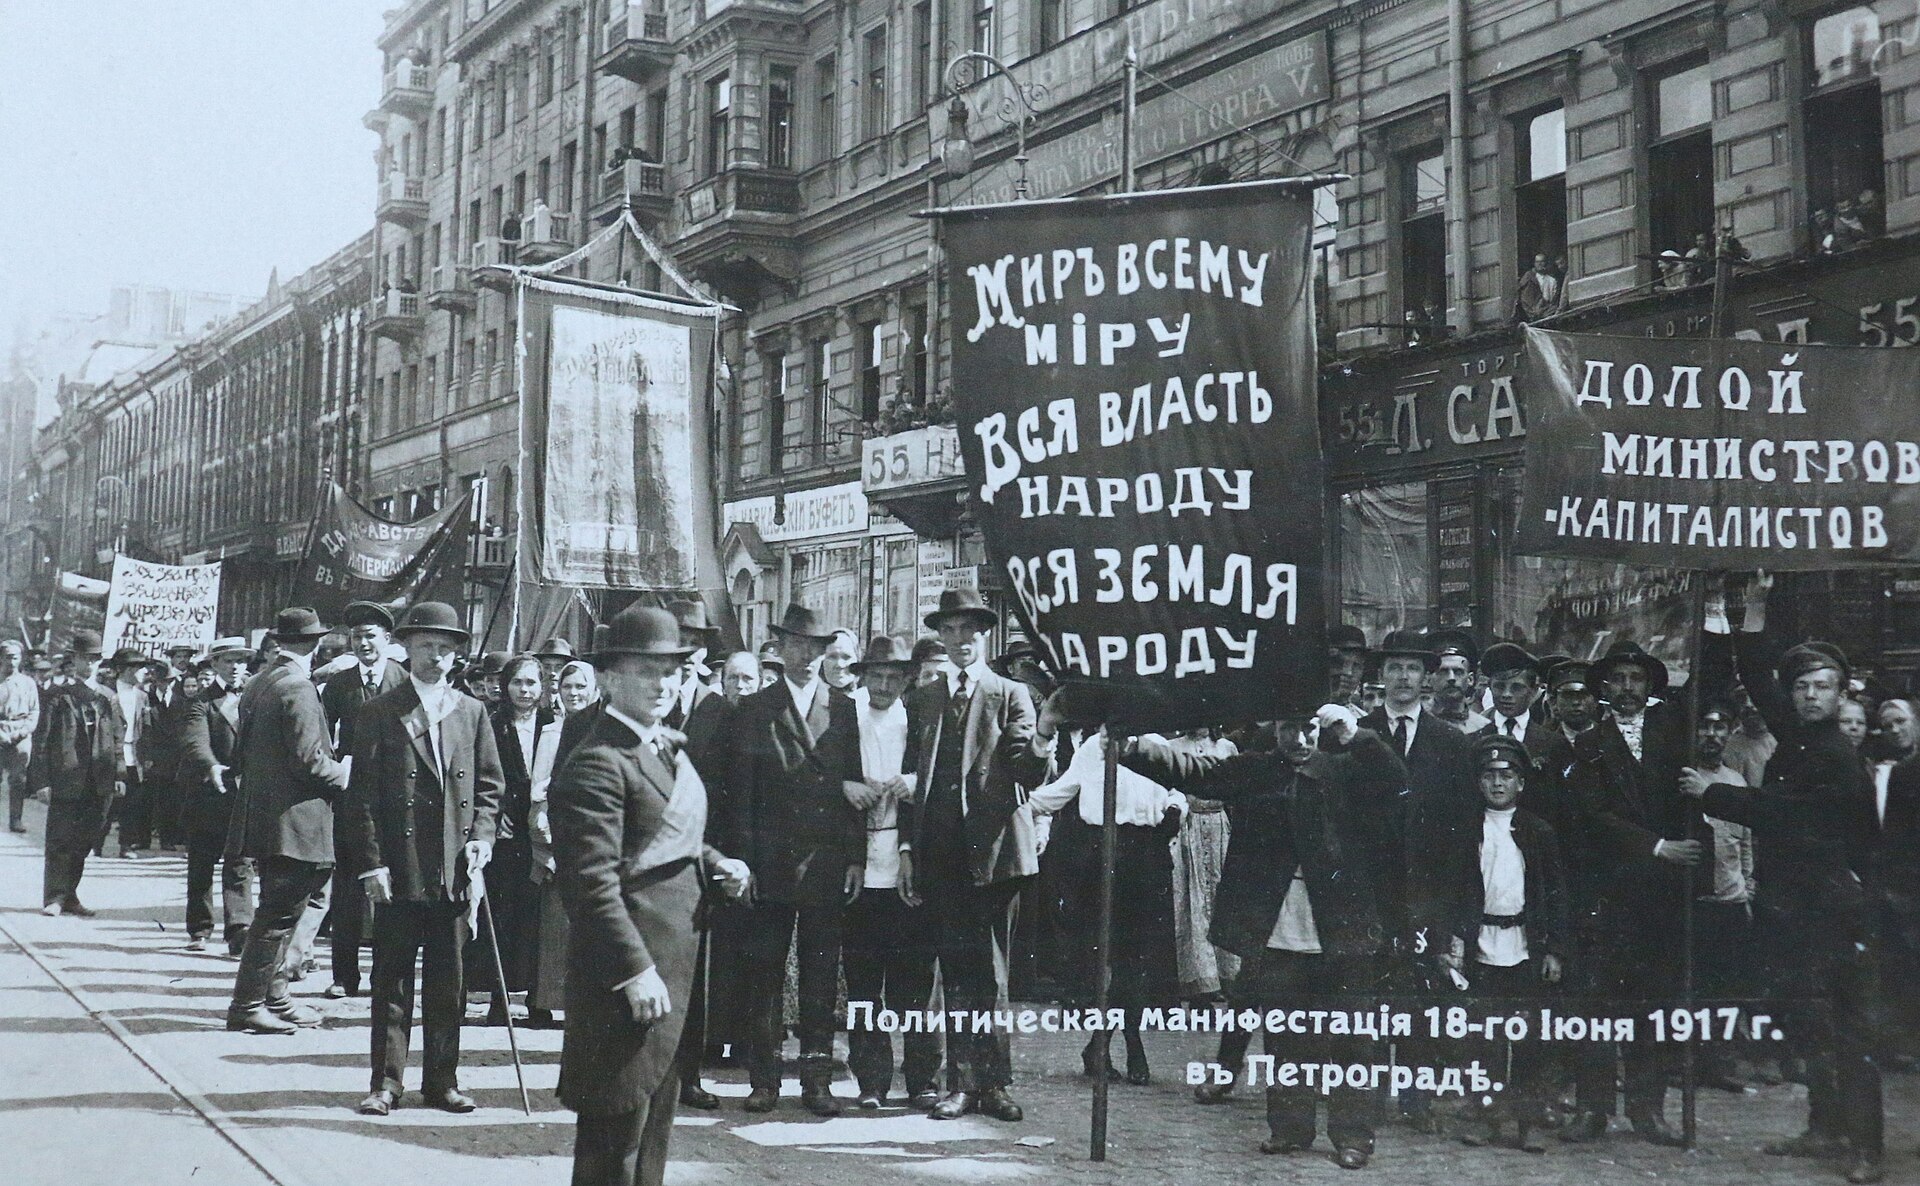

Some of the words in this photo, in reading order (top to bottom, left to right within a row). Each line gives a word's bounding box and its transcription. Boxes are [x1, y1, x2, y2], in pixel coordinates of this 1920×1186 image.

[967, 247, 1105, 342] МИРЪ
[1117, 237, 1269, 307] ВСЕМУ
[1577, 352, 1807, 414] ДОЛОЙ
[870, 444, 910, 486] 55
[974, 397, 1078, 505] ВСЯ
[1100, 370, 1273, 447] ВЛАСТЬ
[1601, 431, 1920, 484] МИНИСТРОВ
[1015, 466, 1253, 519] НАРОДУ
[1006, 547, 1079, 629] ВСЯ
[1093, 544, 1297, 625] ЗЕМЛЯ
